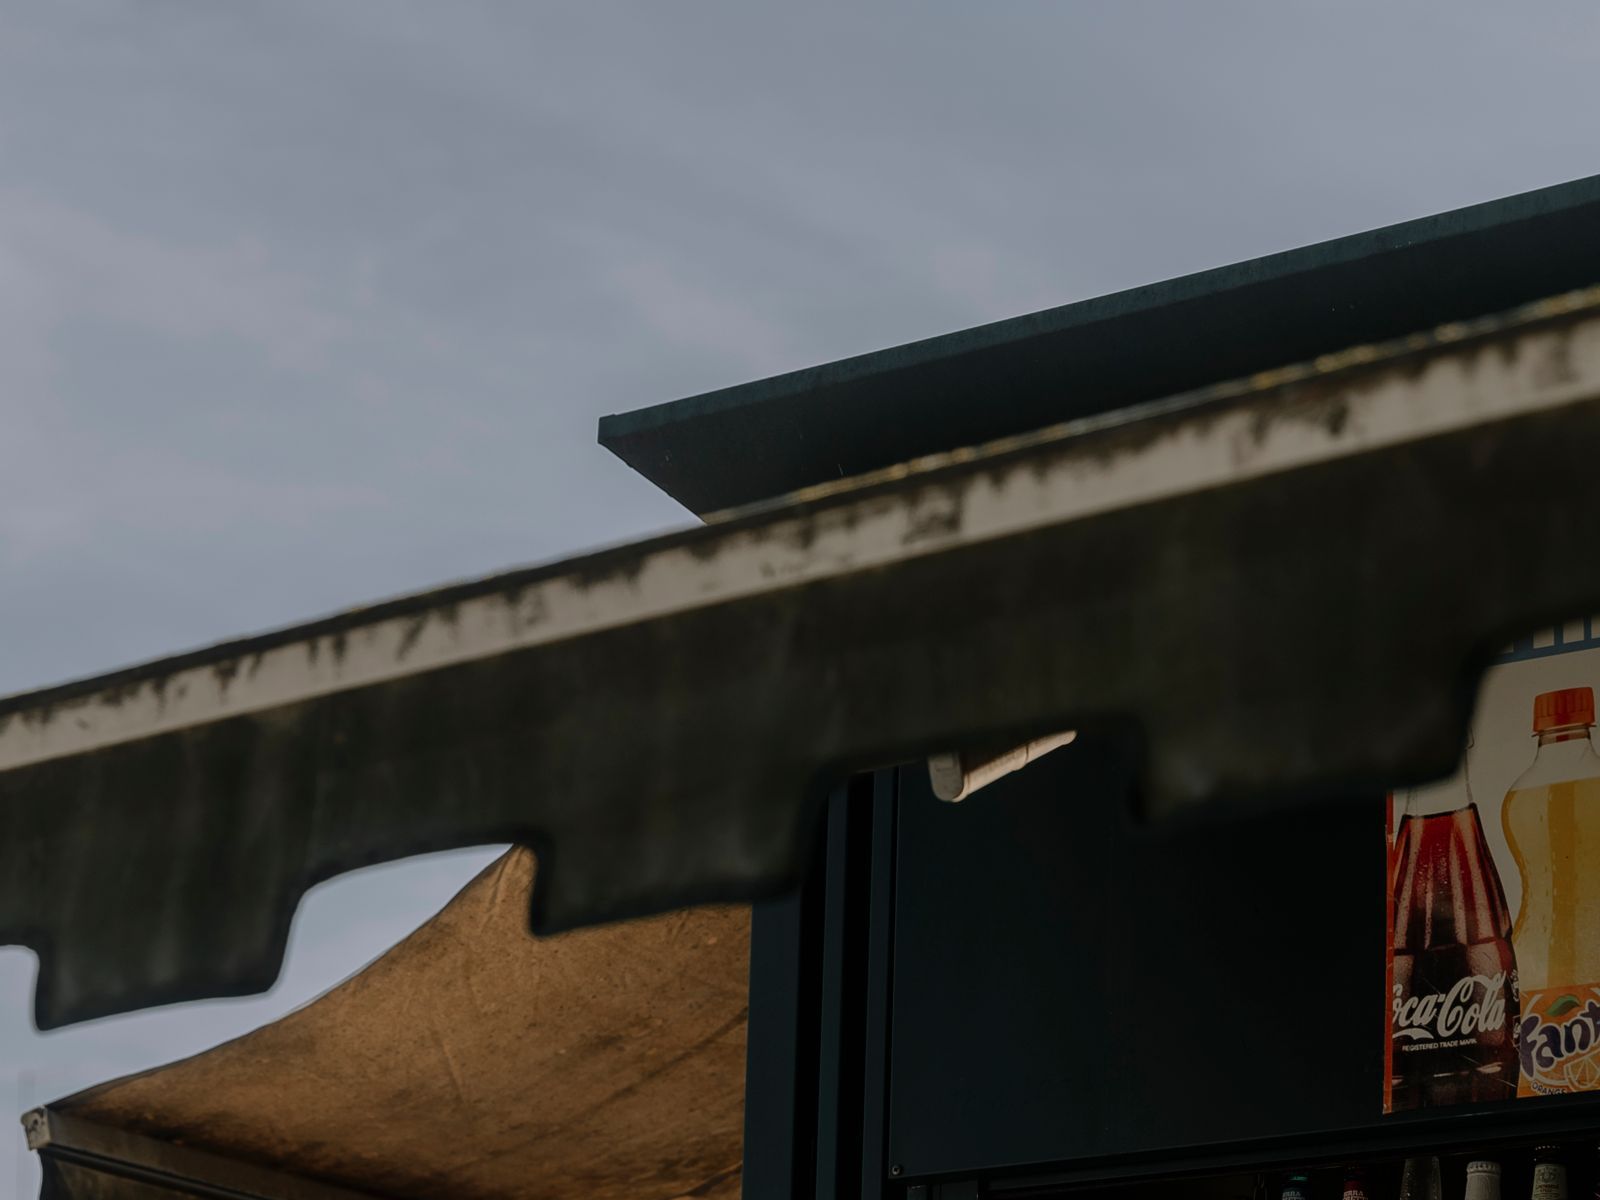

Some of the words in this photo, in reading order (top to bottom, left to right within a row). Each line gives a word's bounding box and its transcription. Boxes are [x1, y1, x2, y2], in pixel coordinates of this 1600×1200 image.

[1392, 970, 1507, 1037] oca-Cola
[1402, 1041, 1439, 1052] REGISTERED
[1440, 1039, 1458, 1049] TRADE
[1459, 1037, 1478, 1047] MARK
